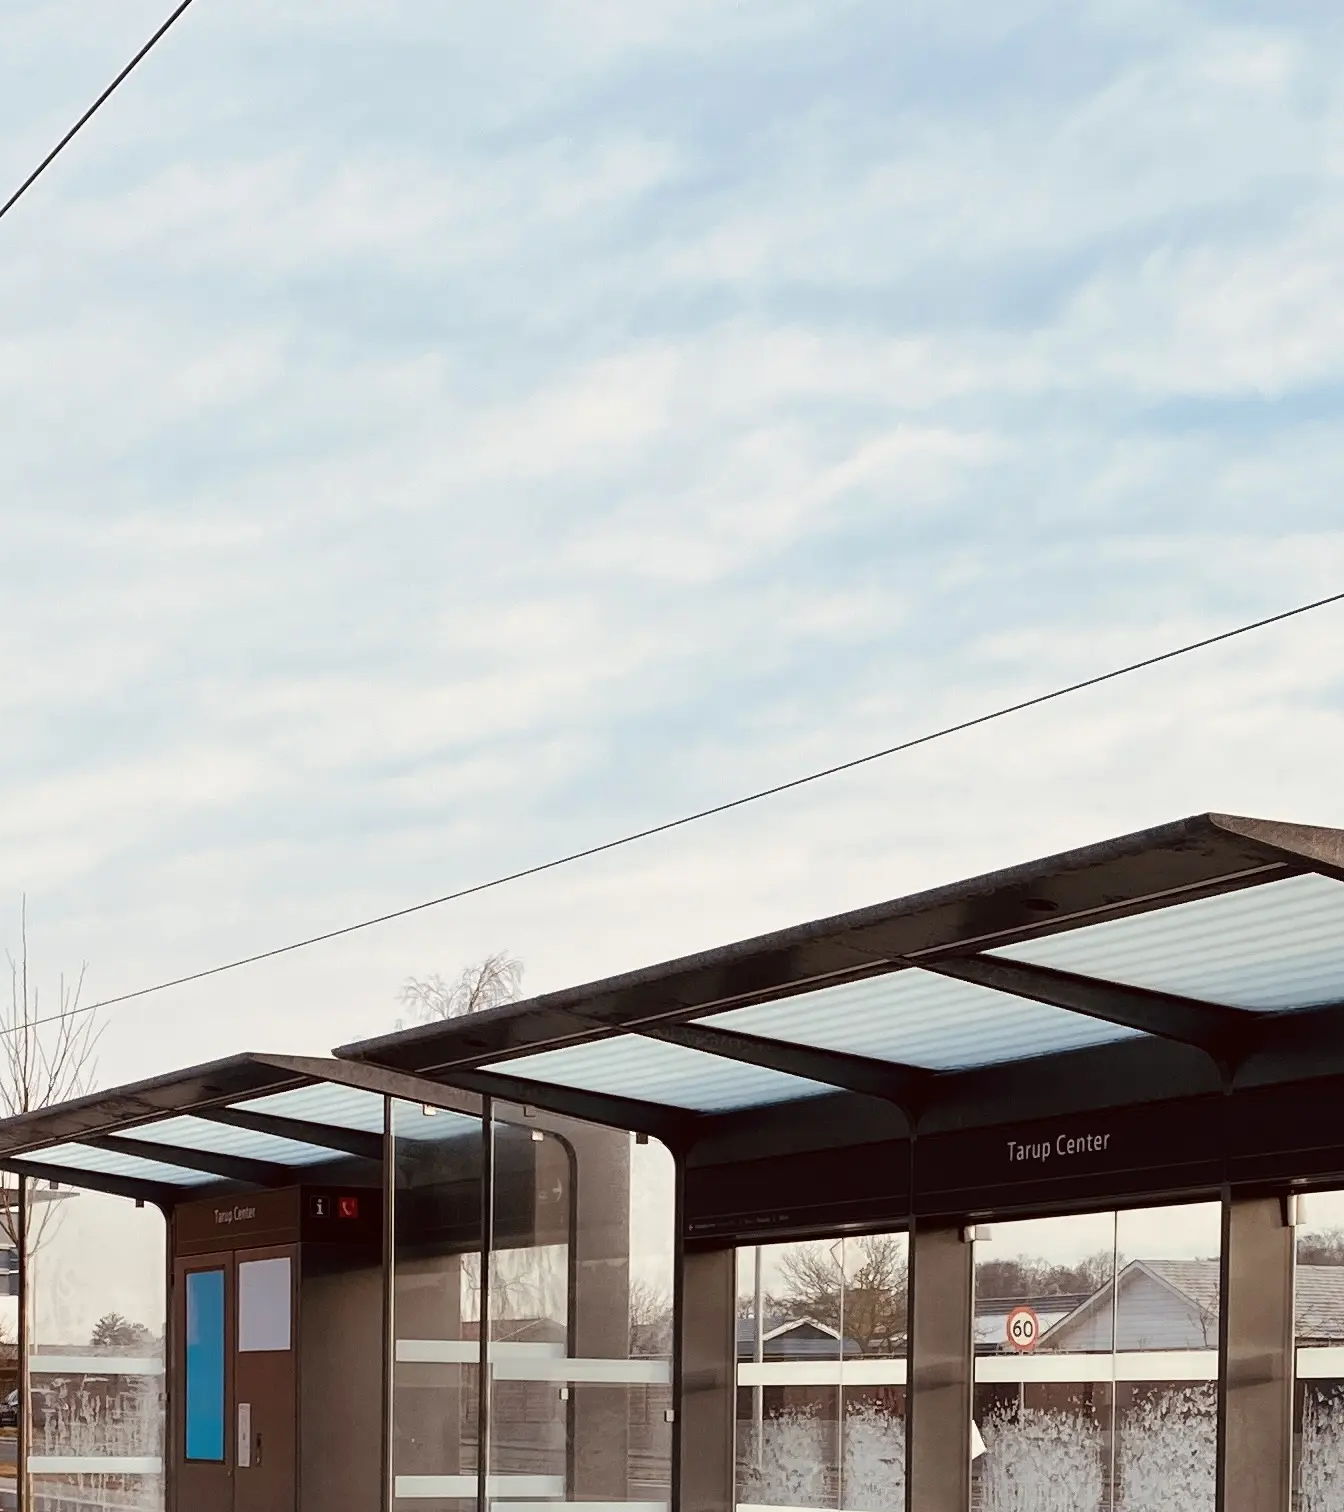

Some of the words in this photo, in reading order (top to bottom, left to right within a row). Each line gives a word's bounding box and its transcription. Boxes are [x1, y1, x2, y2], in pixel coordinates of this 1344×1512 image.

[1007, 1141, 1051, 1162] Tarup
[1056, 1134, 1111, 1156] Center
[1012, 1319, 1033, 1338] 60
